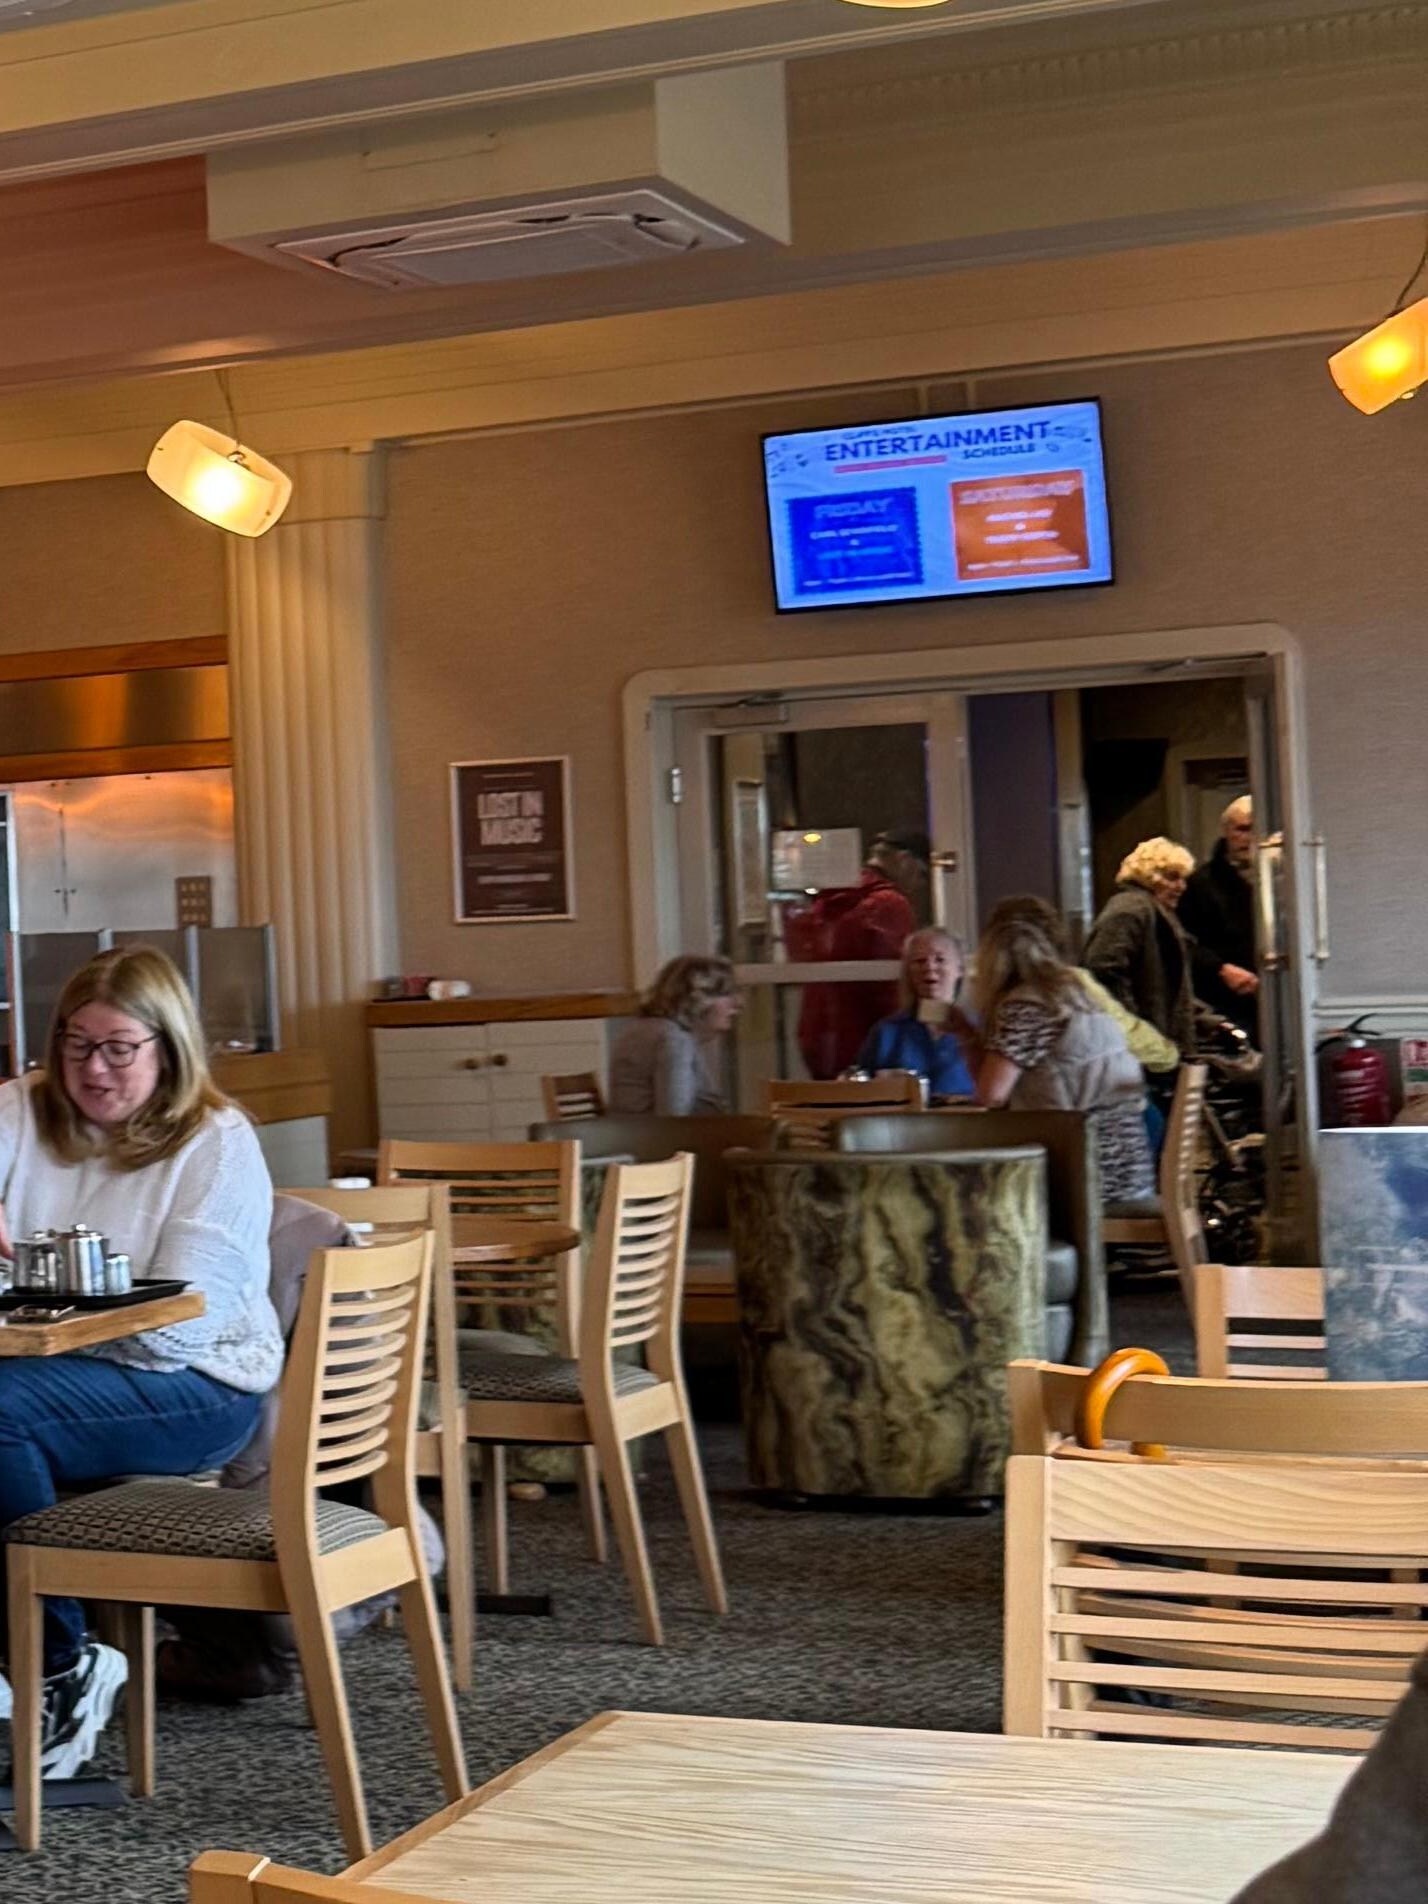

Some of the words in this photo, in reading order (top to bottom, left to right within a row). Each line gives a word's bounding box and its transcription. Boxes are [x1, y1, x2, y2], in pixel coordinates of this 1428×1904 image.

[825, 420, 1050, 461] ENTERTAINMENT
[961, 443, 1036, 460] SCHEDULE
[477, 793, 518, 819] LOST
[480, 816, 543, 846] MUSIC
